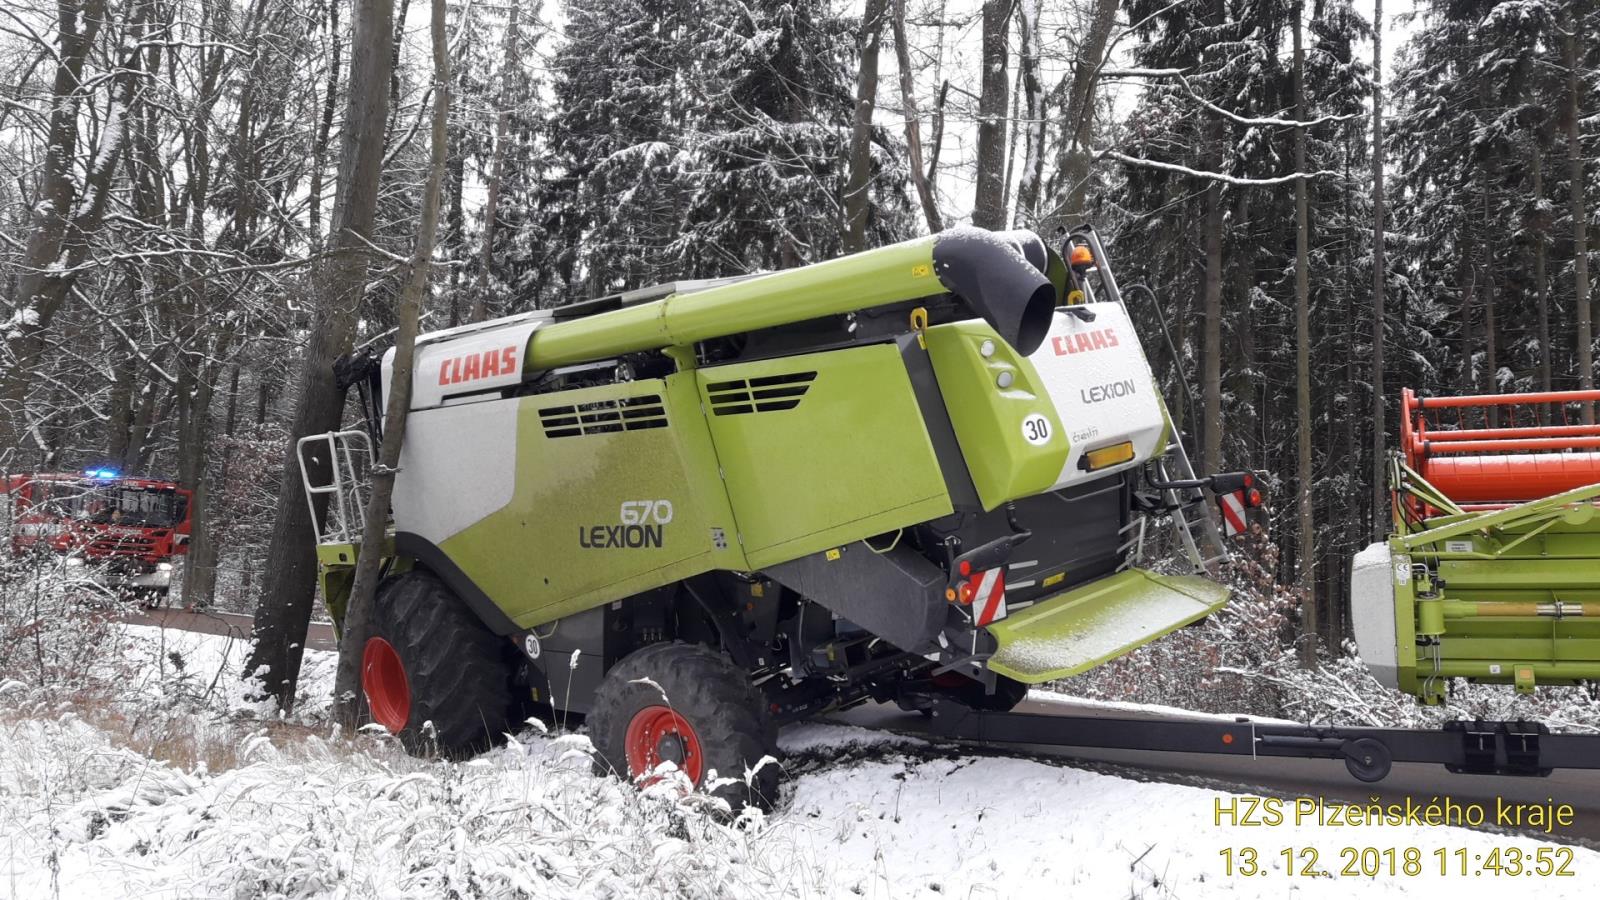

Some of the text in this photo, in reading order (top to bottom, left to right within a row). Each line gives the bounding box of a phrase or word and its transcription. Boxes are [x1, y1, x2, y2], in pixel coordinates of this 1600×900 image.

[1051, 328, 1120, 357] CLAAS
[438, 345, 517, 386] CLAAS
[1080, 378, 1136, 404] LEXION
[1025, 418, 1048, 441] 30
[620, 499, 673, 525] 670
[579, 524, 663, 548] LEXION
[527, 638, 538, 655] 30
